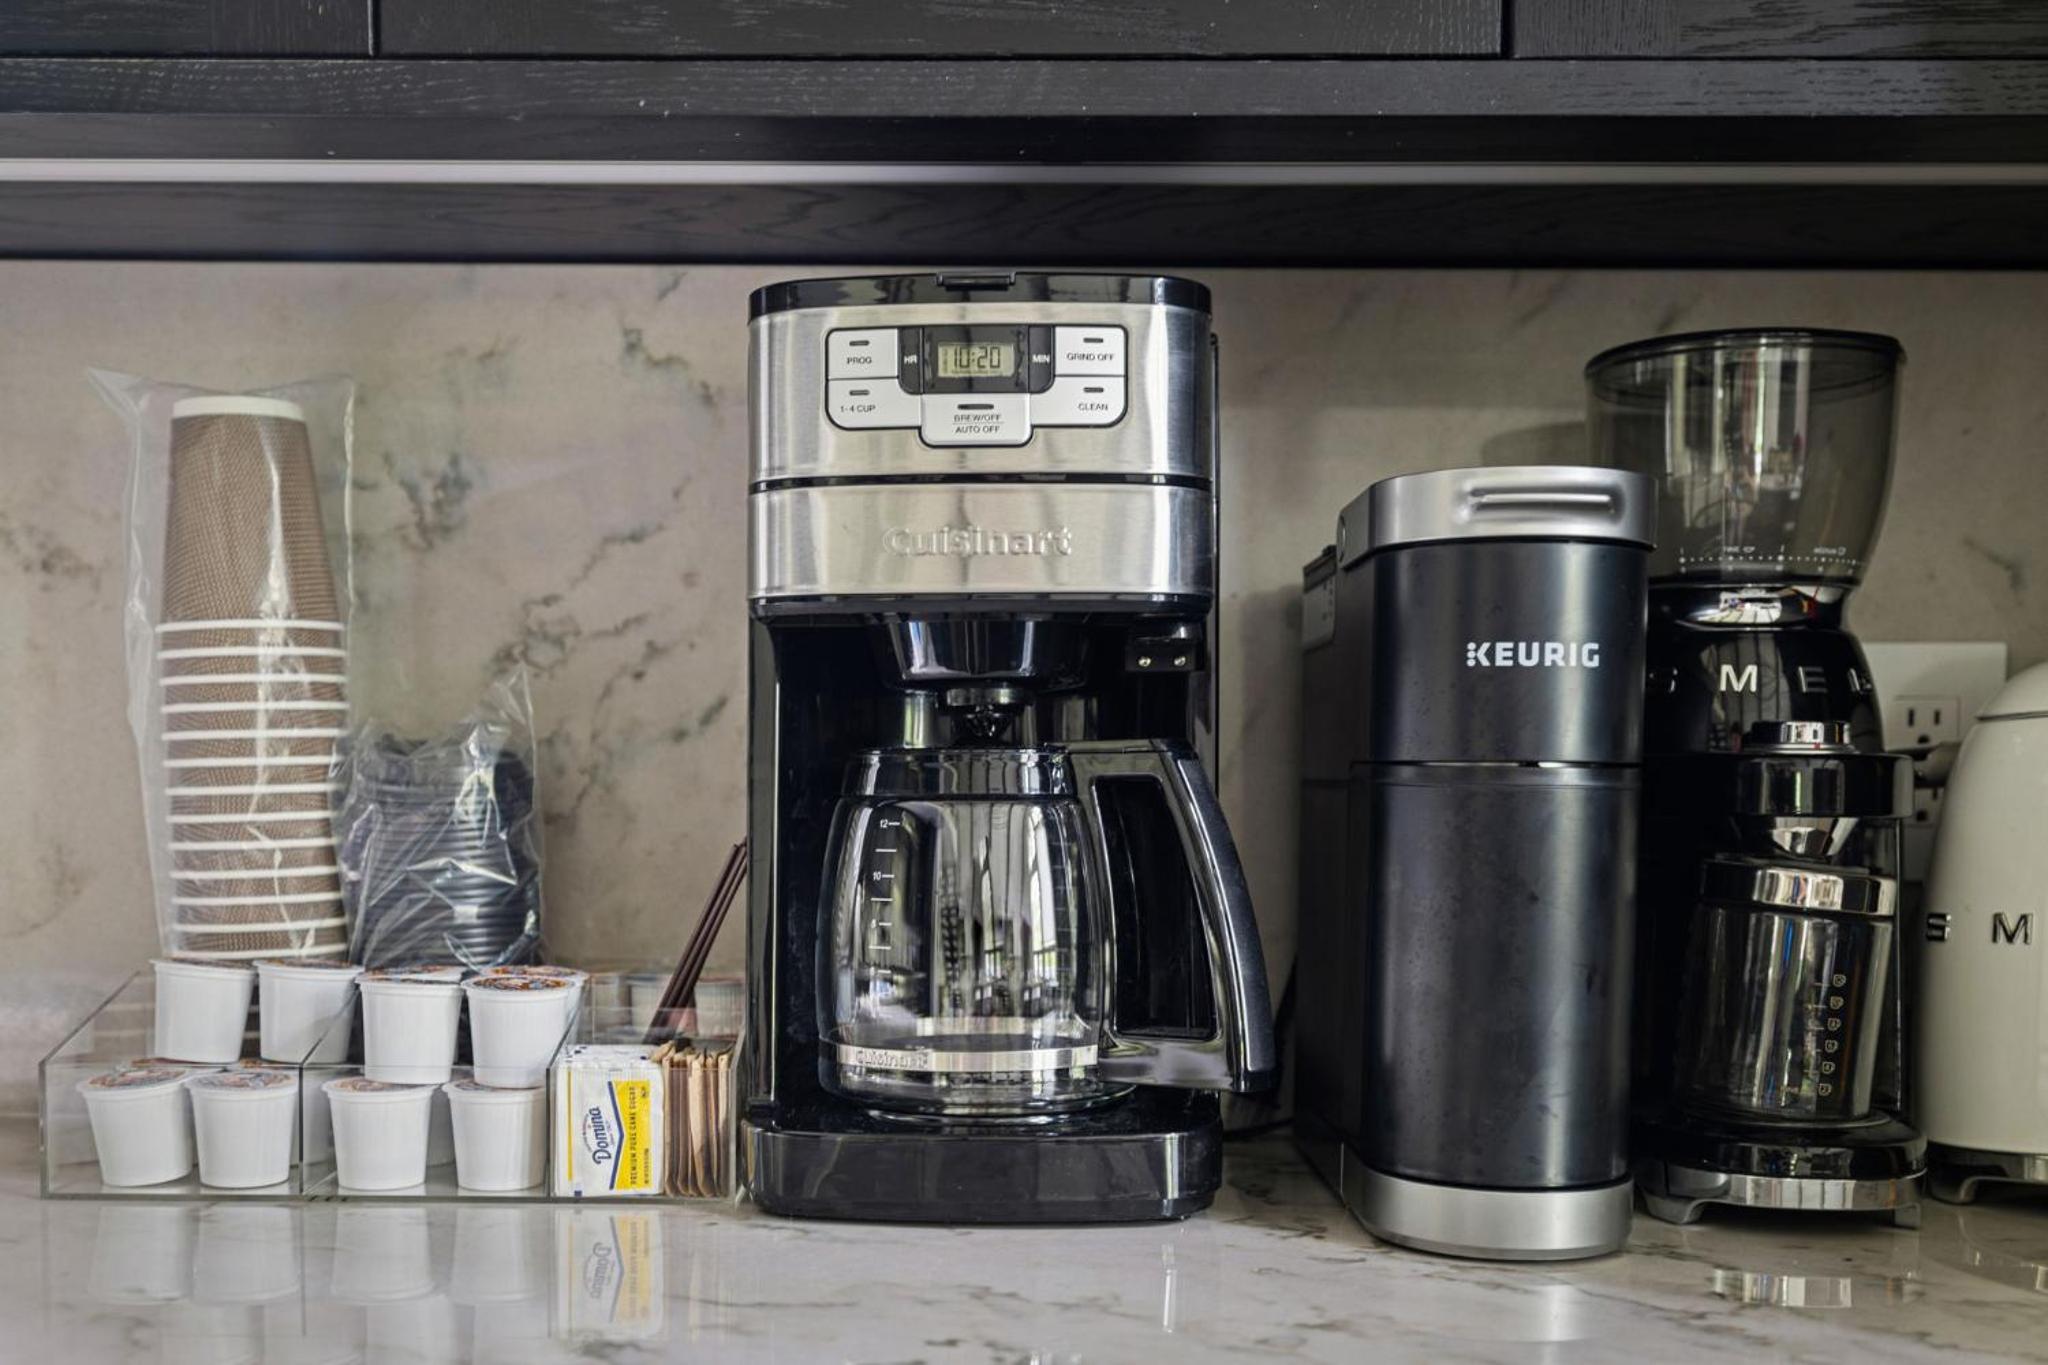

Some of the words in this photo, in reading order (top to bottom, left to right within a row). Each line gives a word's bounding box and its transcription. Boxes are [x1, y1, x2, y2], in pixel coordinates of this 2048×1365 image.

[846, 356, 873, 365] PROG
[903, 354, 918, 364] HR
[953, 346, 1001, 370] 10:20
[1031, 354, 1050, 364] MIN
[1066, 352, 1096, 361] GRIND
[1097, 352, 1114, 361] OFF
[856, 404, 876, 413] CUP
[1078, 403, 1109, 411] CLEAN
[955, 425, 981, 434] AUTO
[982, 425, 1001, 433] OFF
[881, 525, 1072, 557] Cuisinart
[1467, 641, 1600, 668] KEURIG
[879, 819, 889, 829] 12
[873, 871, 882, 881] 10
[589, 1106, 612, 1165] Domino
